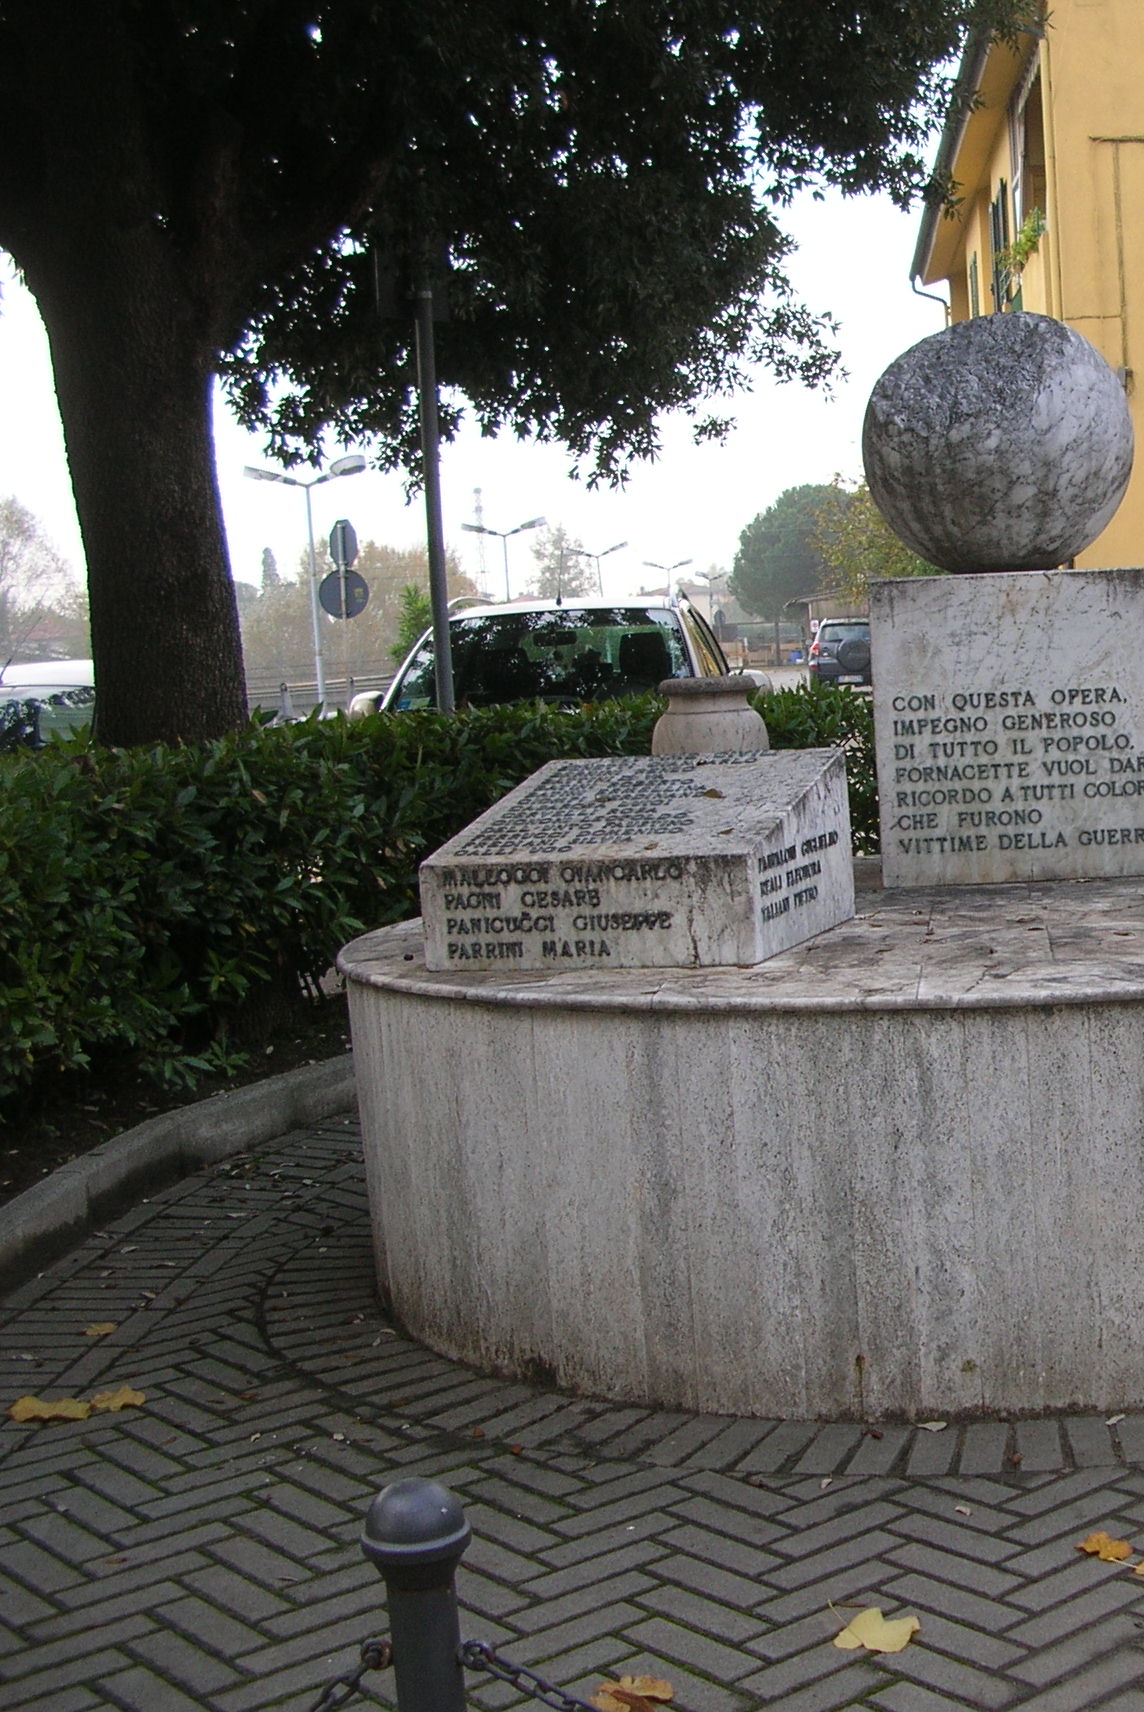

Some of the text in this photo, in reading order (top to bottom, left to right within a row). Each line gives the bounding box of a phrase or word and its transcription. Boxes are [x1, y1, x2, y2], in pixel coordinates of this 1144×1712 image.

[892, 687, 1128, 712] CON QUESTA OPERA,
[893, 711, 1116, 736] IMPEGNO GENEROSO
[894, 743, 915, 760] DI
[929, 739, 998, 758] TUTTO
[1012, 739, 1033, 755] IL
[895, 762, 1030, 784] FORNACETTE
[1042, 759, 1097, 777] VUOL
[896, 787, 992, 808] RICORDO
[1001, 787, 1014, 803] A
[1020, 784, 1075, 801] TUTTI
[898, 809, 1042, 831] CHE FURONO
[898, 834, 988, 855] VITTIME
[998, 831, 1068, 850] DELLA
[560, 863, 683, 884] GIANCARLO
[521, 889, 601, 909] CESARE
[447, 911, 674, 935] PANICUCCI GIUSEPPE
[448, 939, 611, 960] PARRINI MARIA
